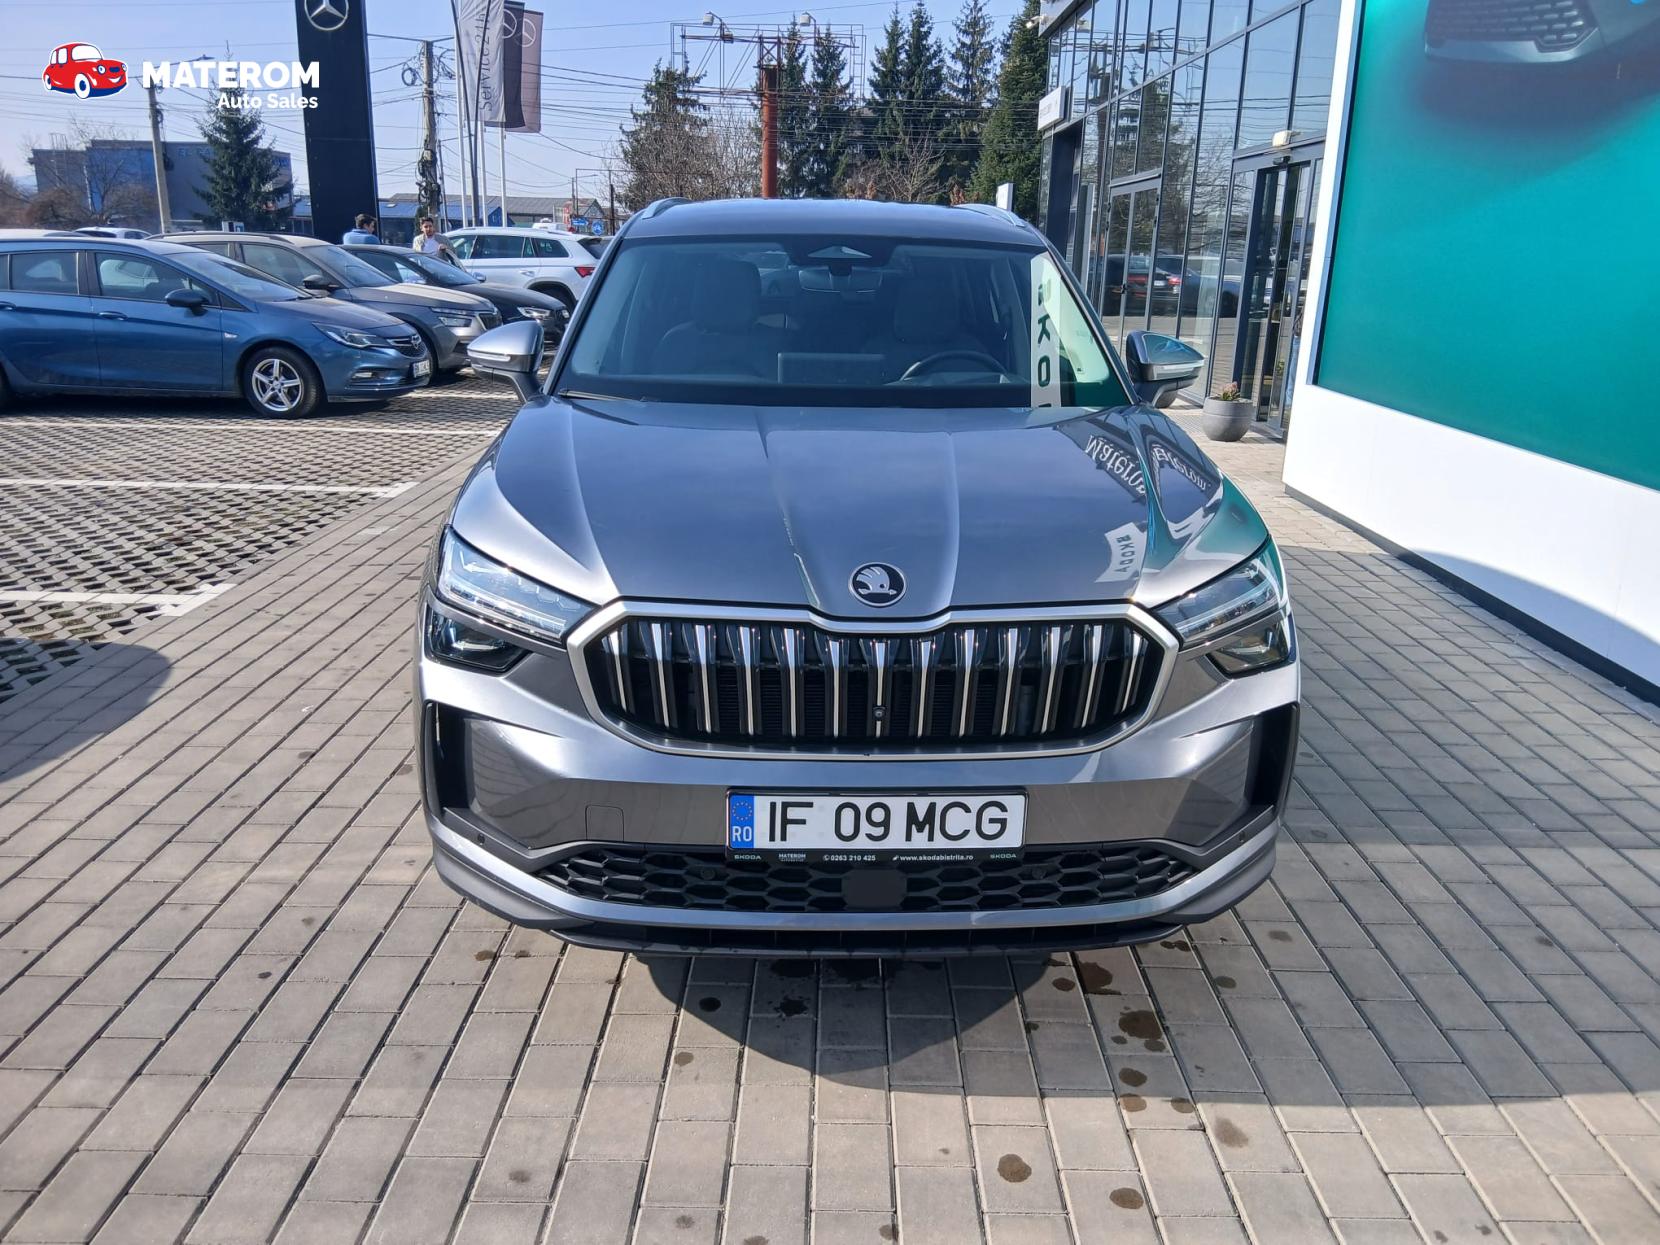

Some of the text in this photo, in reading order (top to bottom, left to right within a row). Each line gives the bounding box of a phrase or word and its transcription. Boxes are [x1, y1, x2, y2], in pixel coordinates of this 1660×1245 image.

[478, 47, 493, 112] Service
[732, 826, 753, 842] RO
[769, 800, 1009, 842] IF 09 MCG
